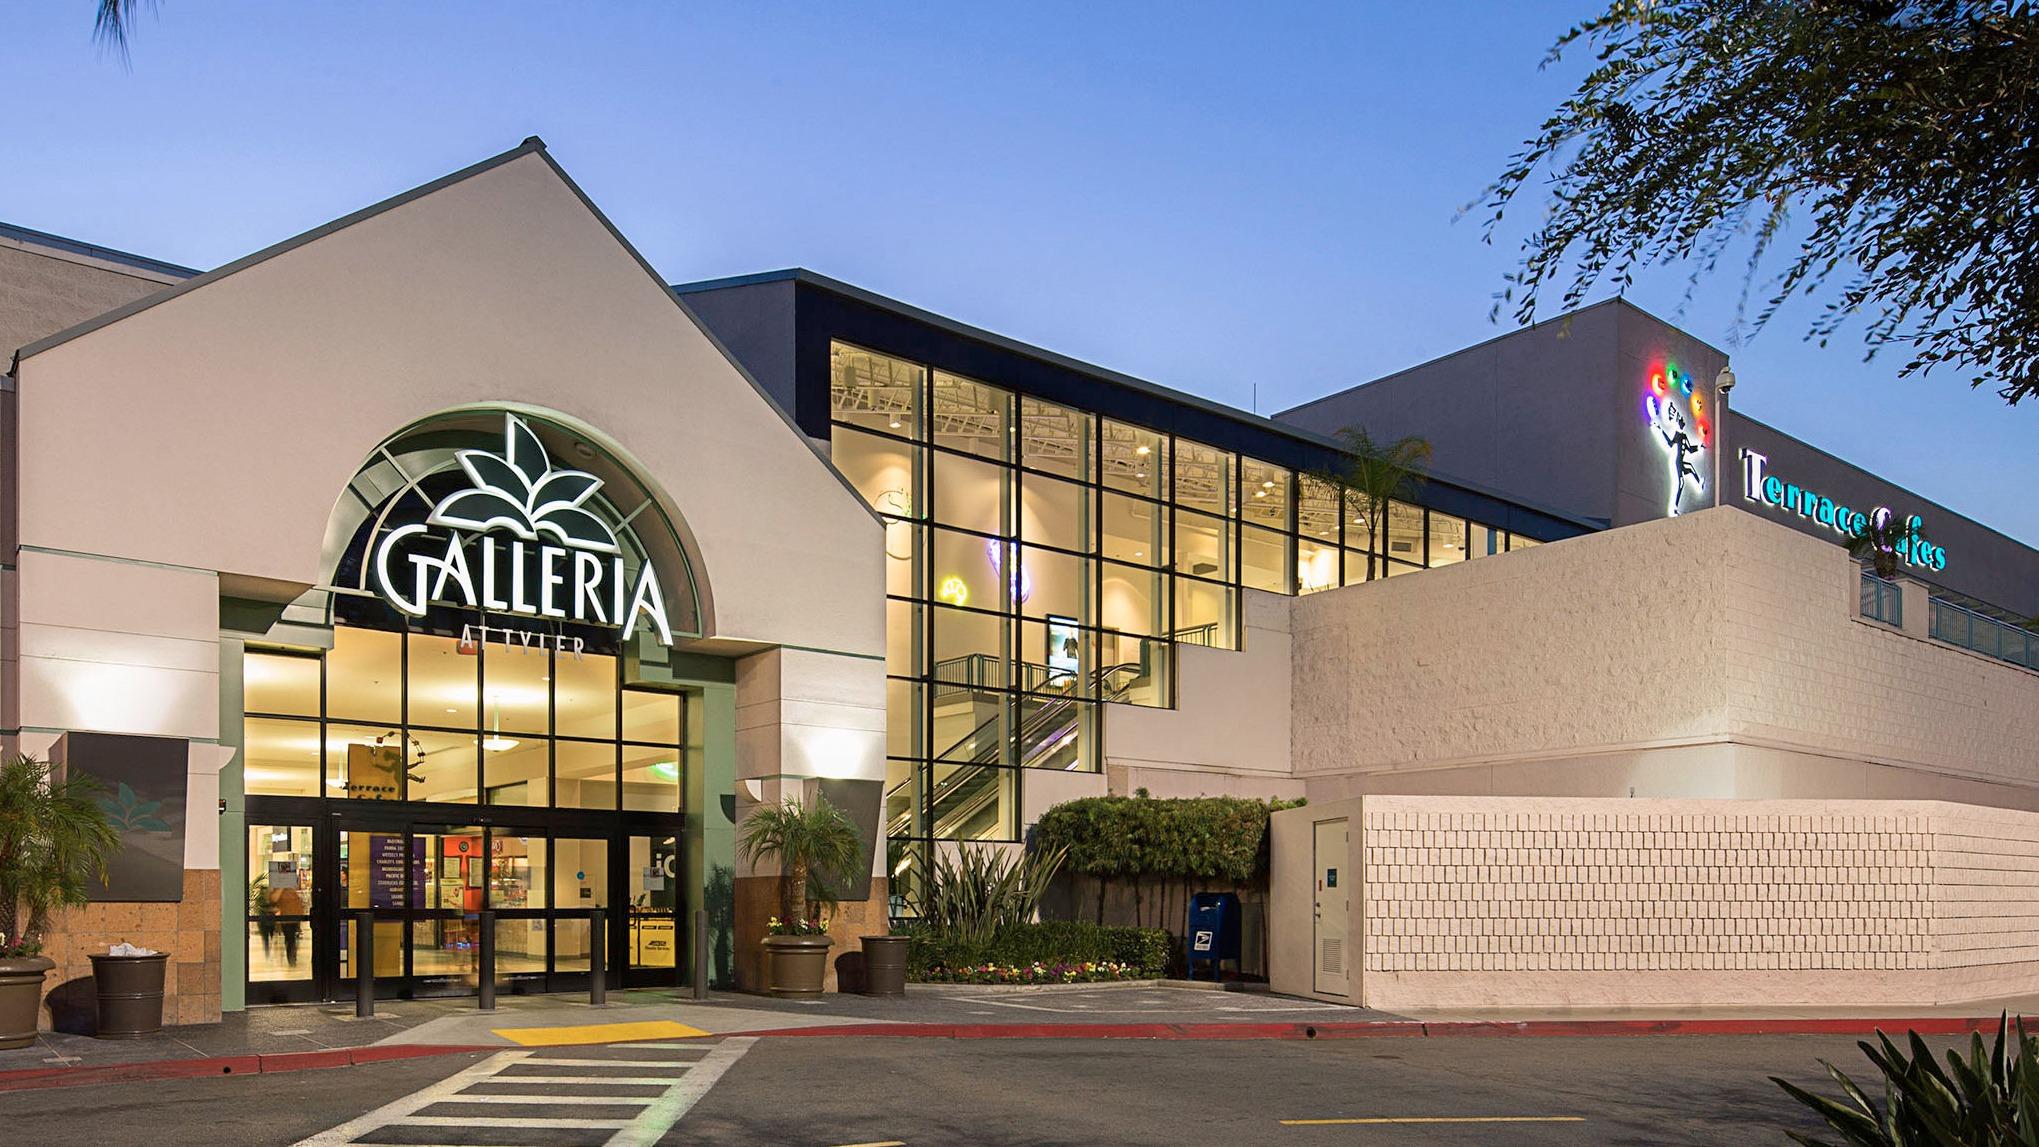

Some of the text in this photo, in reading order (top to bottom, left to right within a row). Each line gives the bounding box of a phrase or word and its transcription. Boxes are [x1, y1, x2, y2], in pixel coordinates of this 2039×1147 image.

[1739, 447, 1869, 539] Terrace
[377, 523, 674, 646] GALLERIA
[460, 623, 585, 662] AT TYLER
[343, 781, 396, 794] errace
